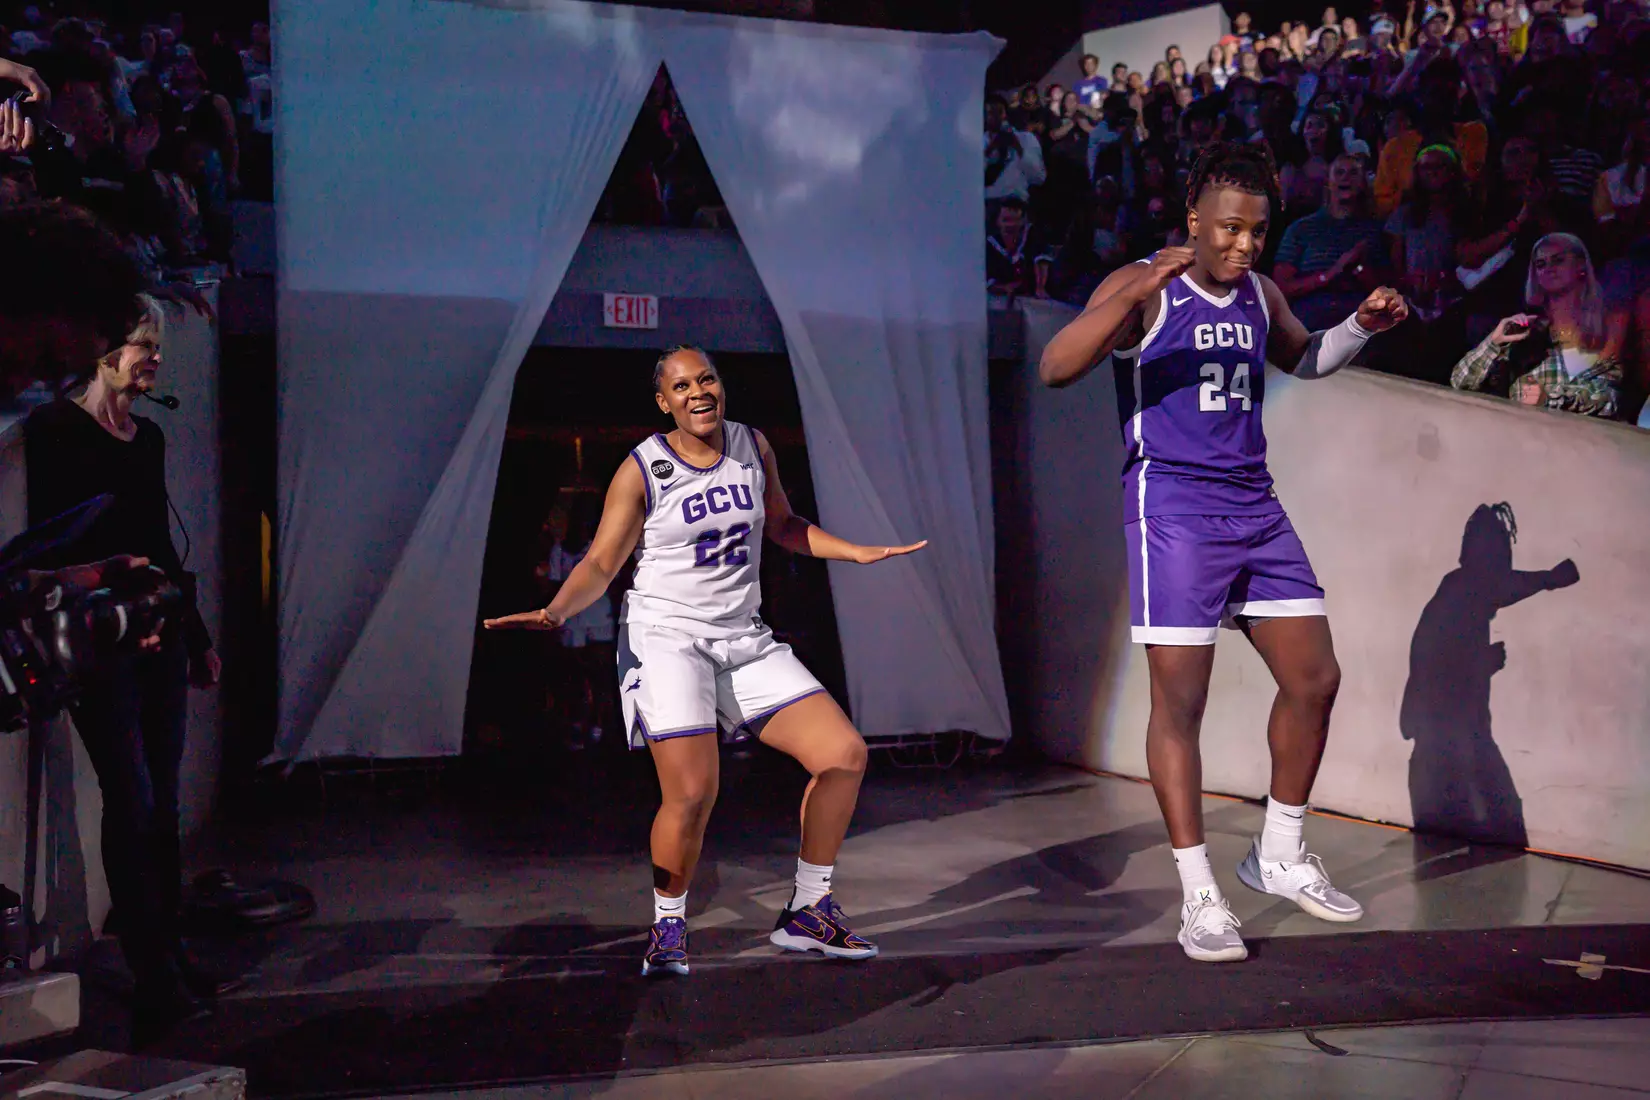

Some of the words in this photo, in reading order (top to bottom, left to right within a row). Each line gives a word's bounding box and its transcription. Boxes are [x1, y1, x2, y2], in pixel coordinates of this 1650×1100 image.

[614, 296, 650, 325] EXIT
[1194, 322, 1253, 351] GCU
[1200, 363, 1252, 411] 24
[682, 484, 754, 525] GCU
[695, 521, 752, 567] 22
